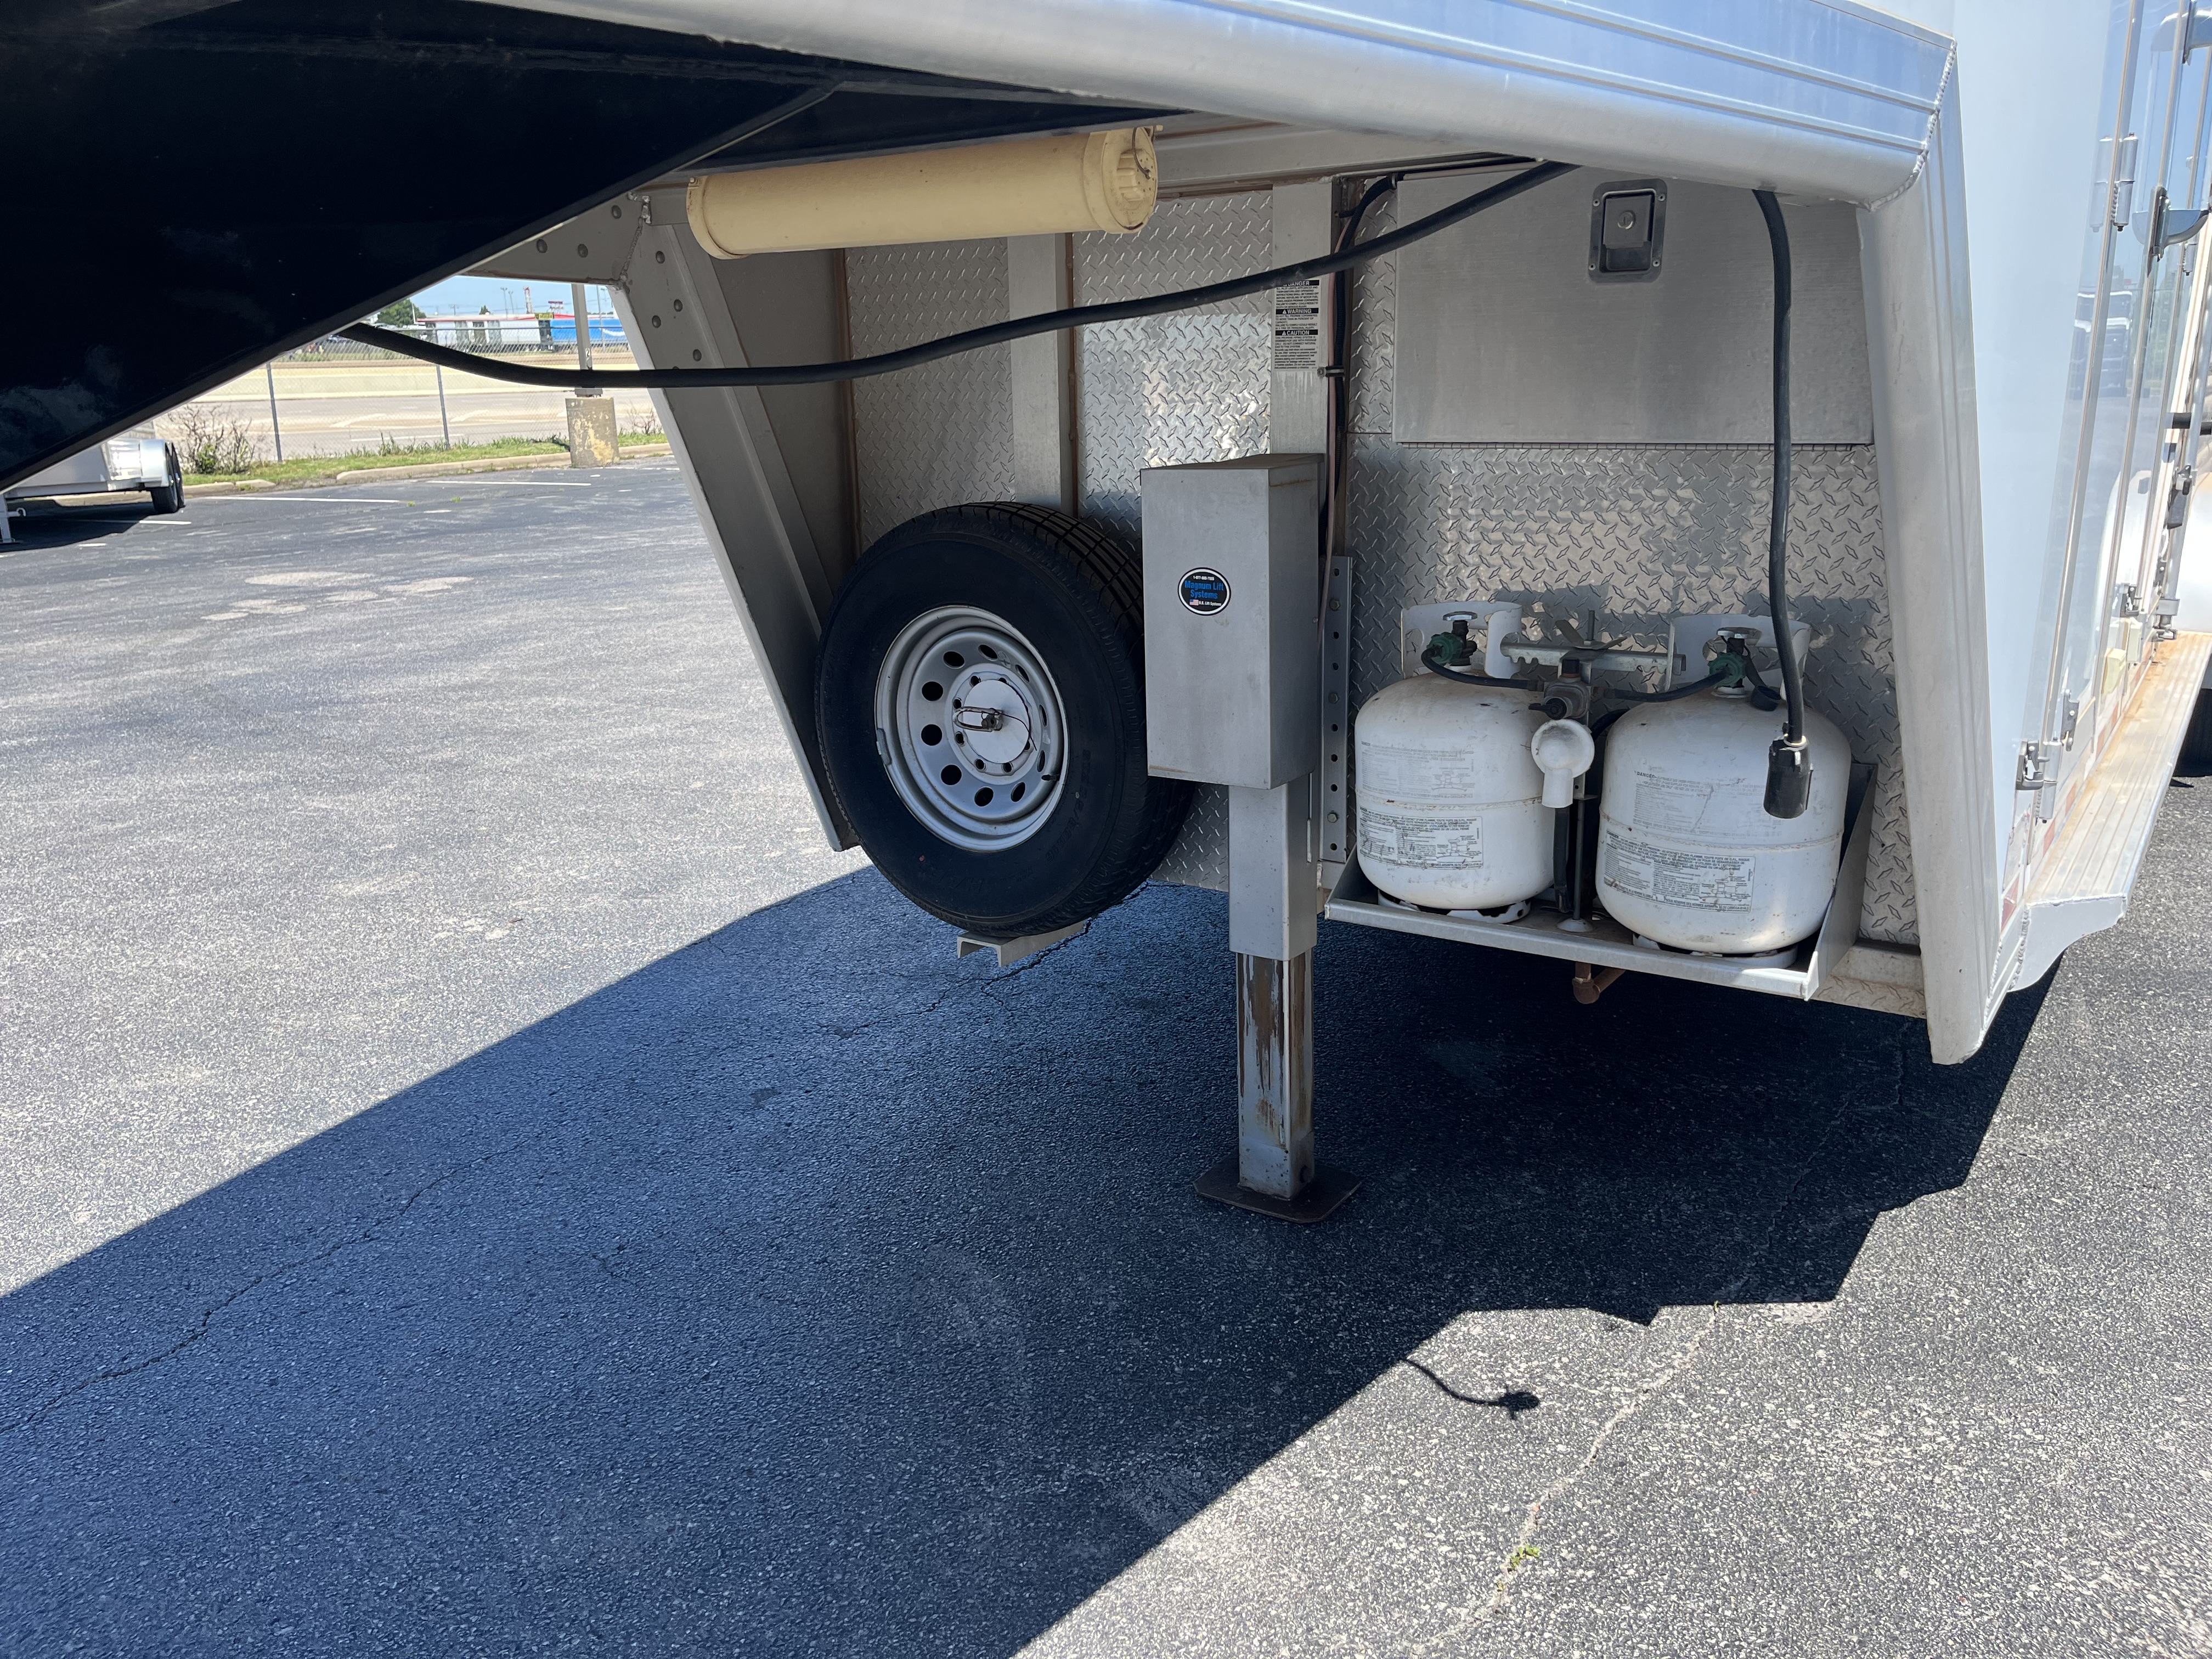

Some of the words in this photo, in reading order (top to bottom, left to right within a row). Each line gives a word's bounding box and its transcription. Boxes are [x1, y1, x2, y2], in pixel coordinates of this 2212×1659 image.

[1185, 580, 1211, 590] Magnum
[1213, 582, 1224, 591] Lift
[1190, 589, 1218, 599] Systems
